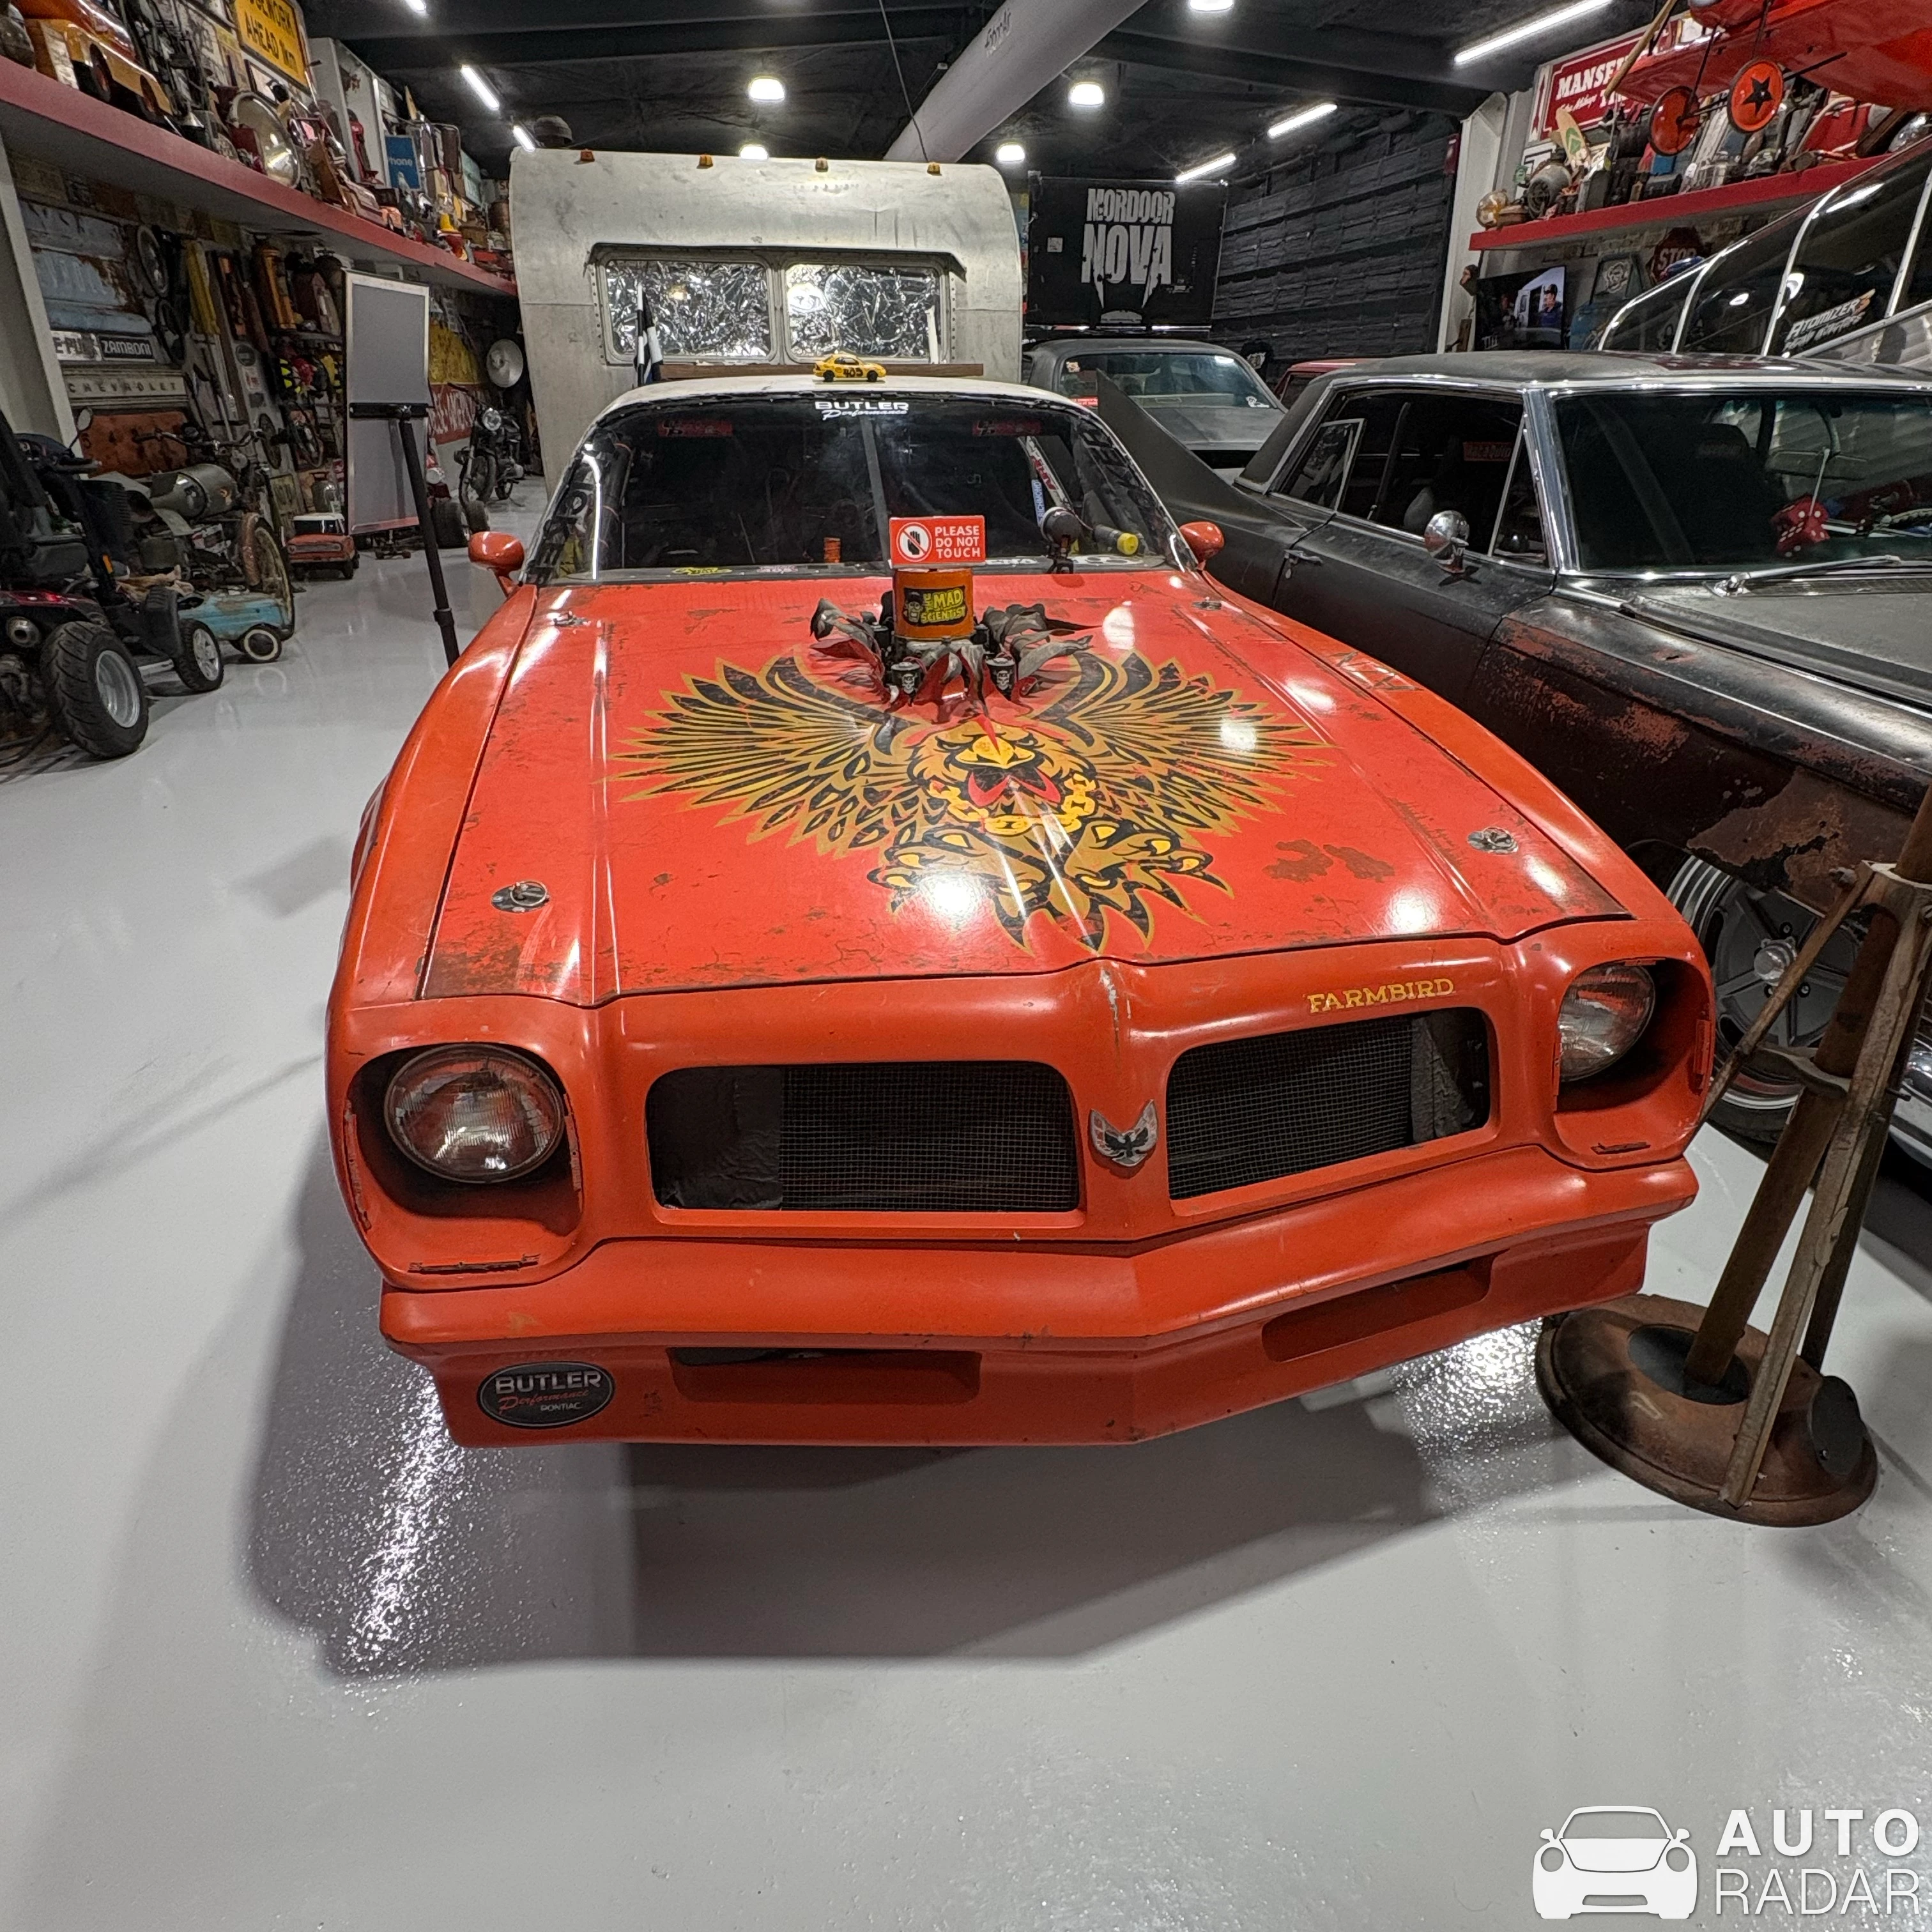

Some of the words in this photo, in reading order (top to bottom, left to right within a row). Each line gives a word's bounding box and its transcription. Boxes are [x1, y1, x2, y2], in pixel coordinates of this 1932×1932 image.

[245, 10, 279, 59] AHEAD
[1086, 188, 1176, 224] MORDOOR
[1081, 224, 1172, 295] NOVA
[1784, 298, 1860, 343] ATOMIZER
[101, 340, 152, 355] ZAMBONI
[68, 381, 177, 394] CHEVROLET
[815, 401, 909, 411] BUTLER
[822, 409, 908, 421] Performance
[1033, 481, 1045, 518] RICHMOND
[935, 525, 979, 537] PLEASE
[935, 538, 953, 548] DO
[956, 537, 979, 548] NOT
[936, 548, 981, 559] TOUCH
[933, 588, 963, 610] MAD
[1307, 978, 1457, 1013] FARMBIRD
[496, 1370, 602, 1395] BUTLER
[498, 1390, 590, 1414] Performance
[540, 1402, 583, 1411] PONTIAC
